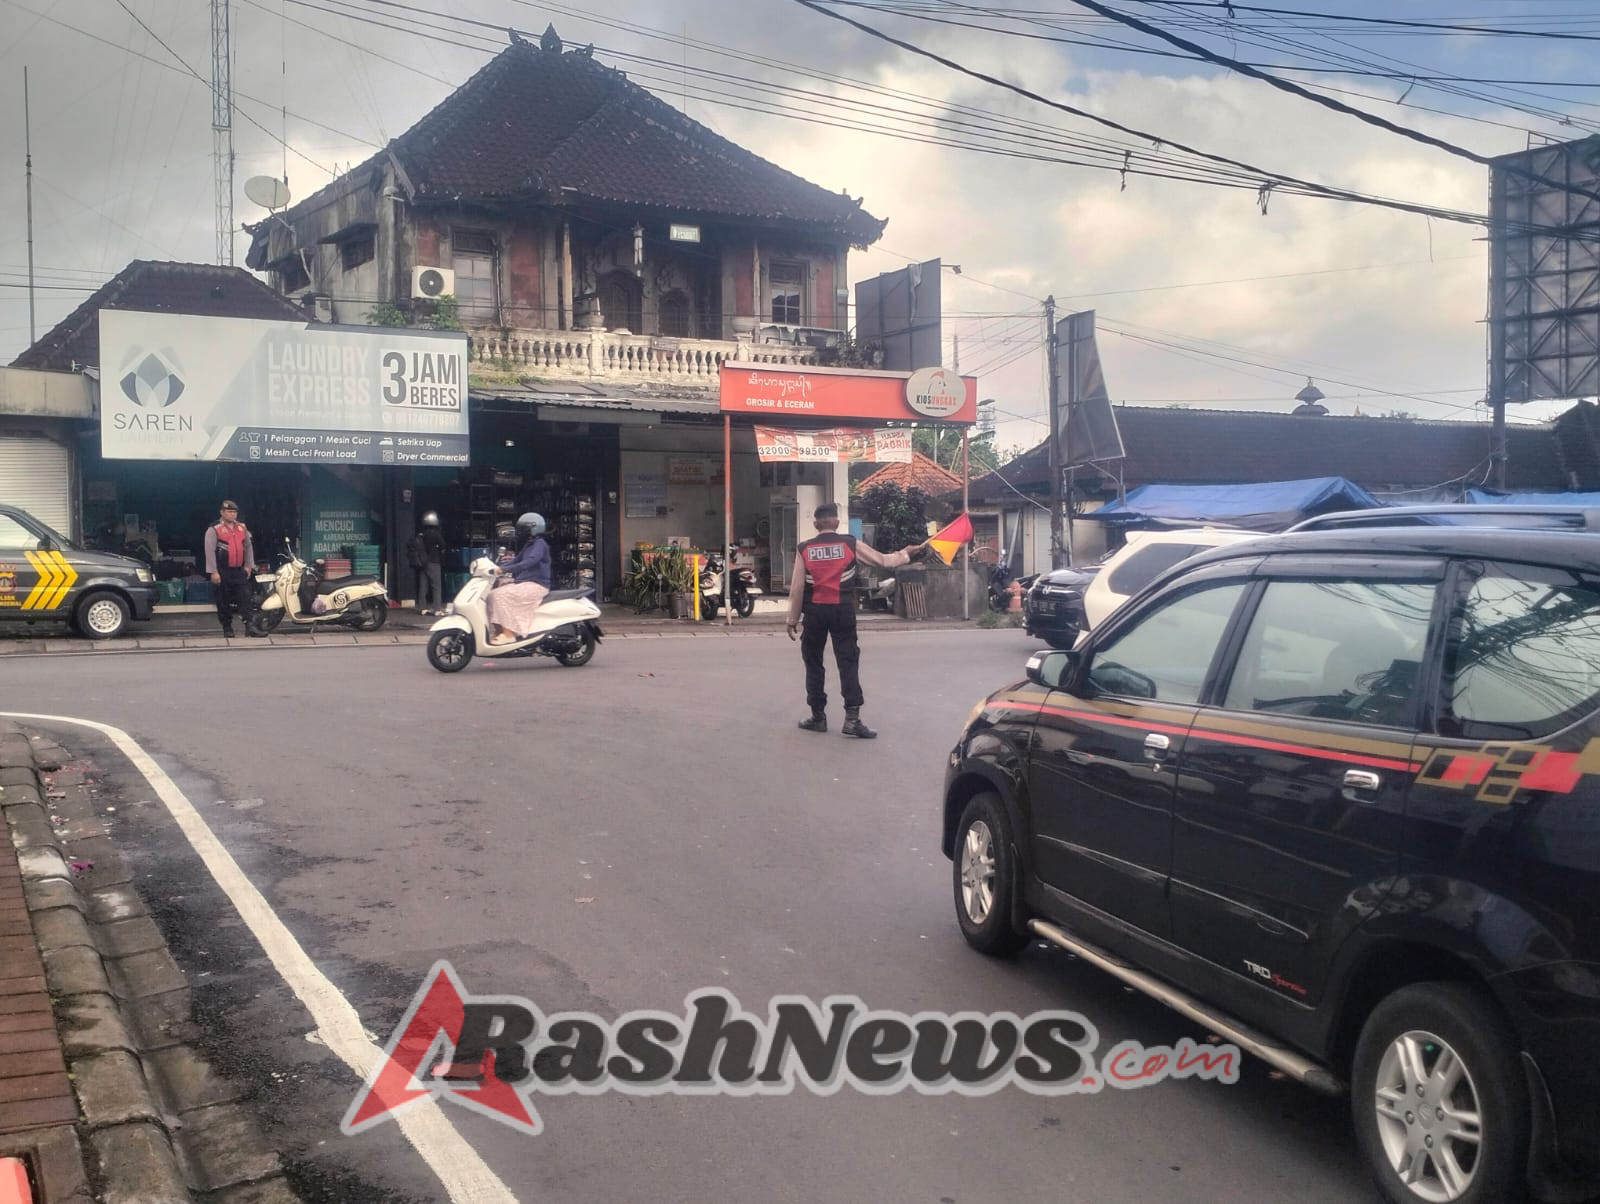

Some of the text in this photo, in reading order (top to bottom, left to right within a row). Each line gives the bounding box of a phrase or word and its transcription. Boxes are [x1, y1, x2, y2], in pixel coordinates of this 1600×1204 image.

[268, 343, 369, 375] LAUNDRY
[383, 352, 457, 404] 3 JAM
[268, 373, 370, 405] EXPRESS
[410, 386, 457, 407] BERES
[746, 397, 775, 407] GROSIR
[784, 400, 815, 409] ECERAN
[114, 413, 193, 431] SAREN
[270, 434, 317, 444] Pelanggan
[325, 436, 351, 444] Mesin
[352, 436, 371, 445] Cuci
[397, 438, 442, 448] Setrika Uap
[265, 448, 357, 458] Mesin Cuci Front Load
[759, 446, 790, 455] 32000
[397, 452, 468, 462] Dryer Commercial
[315, 520, 354, 531] MENCUCI
[314, 543, 341, 553] ADALAH
[809, 545, 843, 560] POLISI
[1243, 959, 1271, 979] TRD
